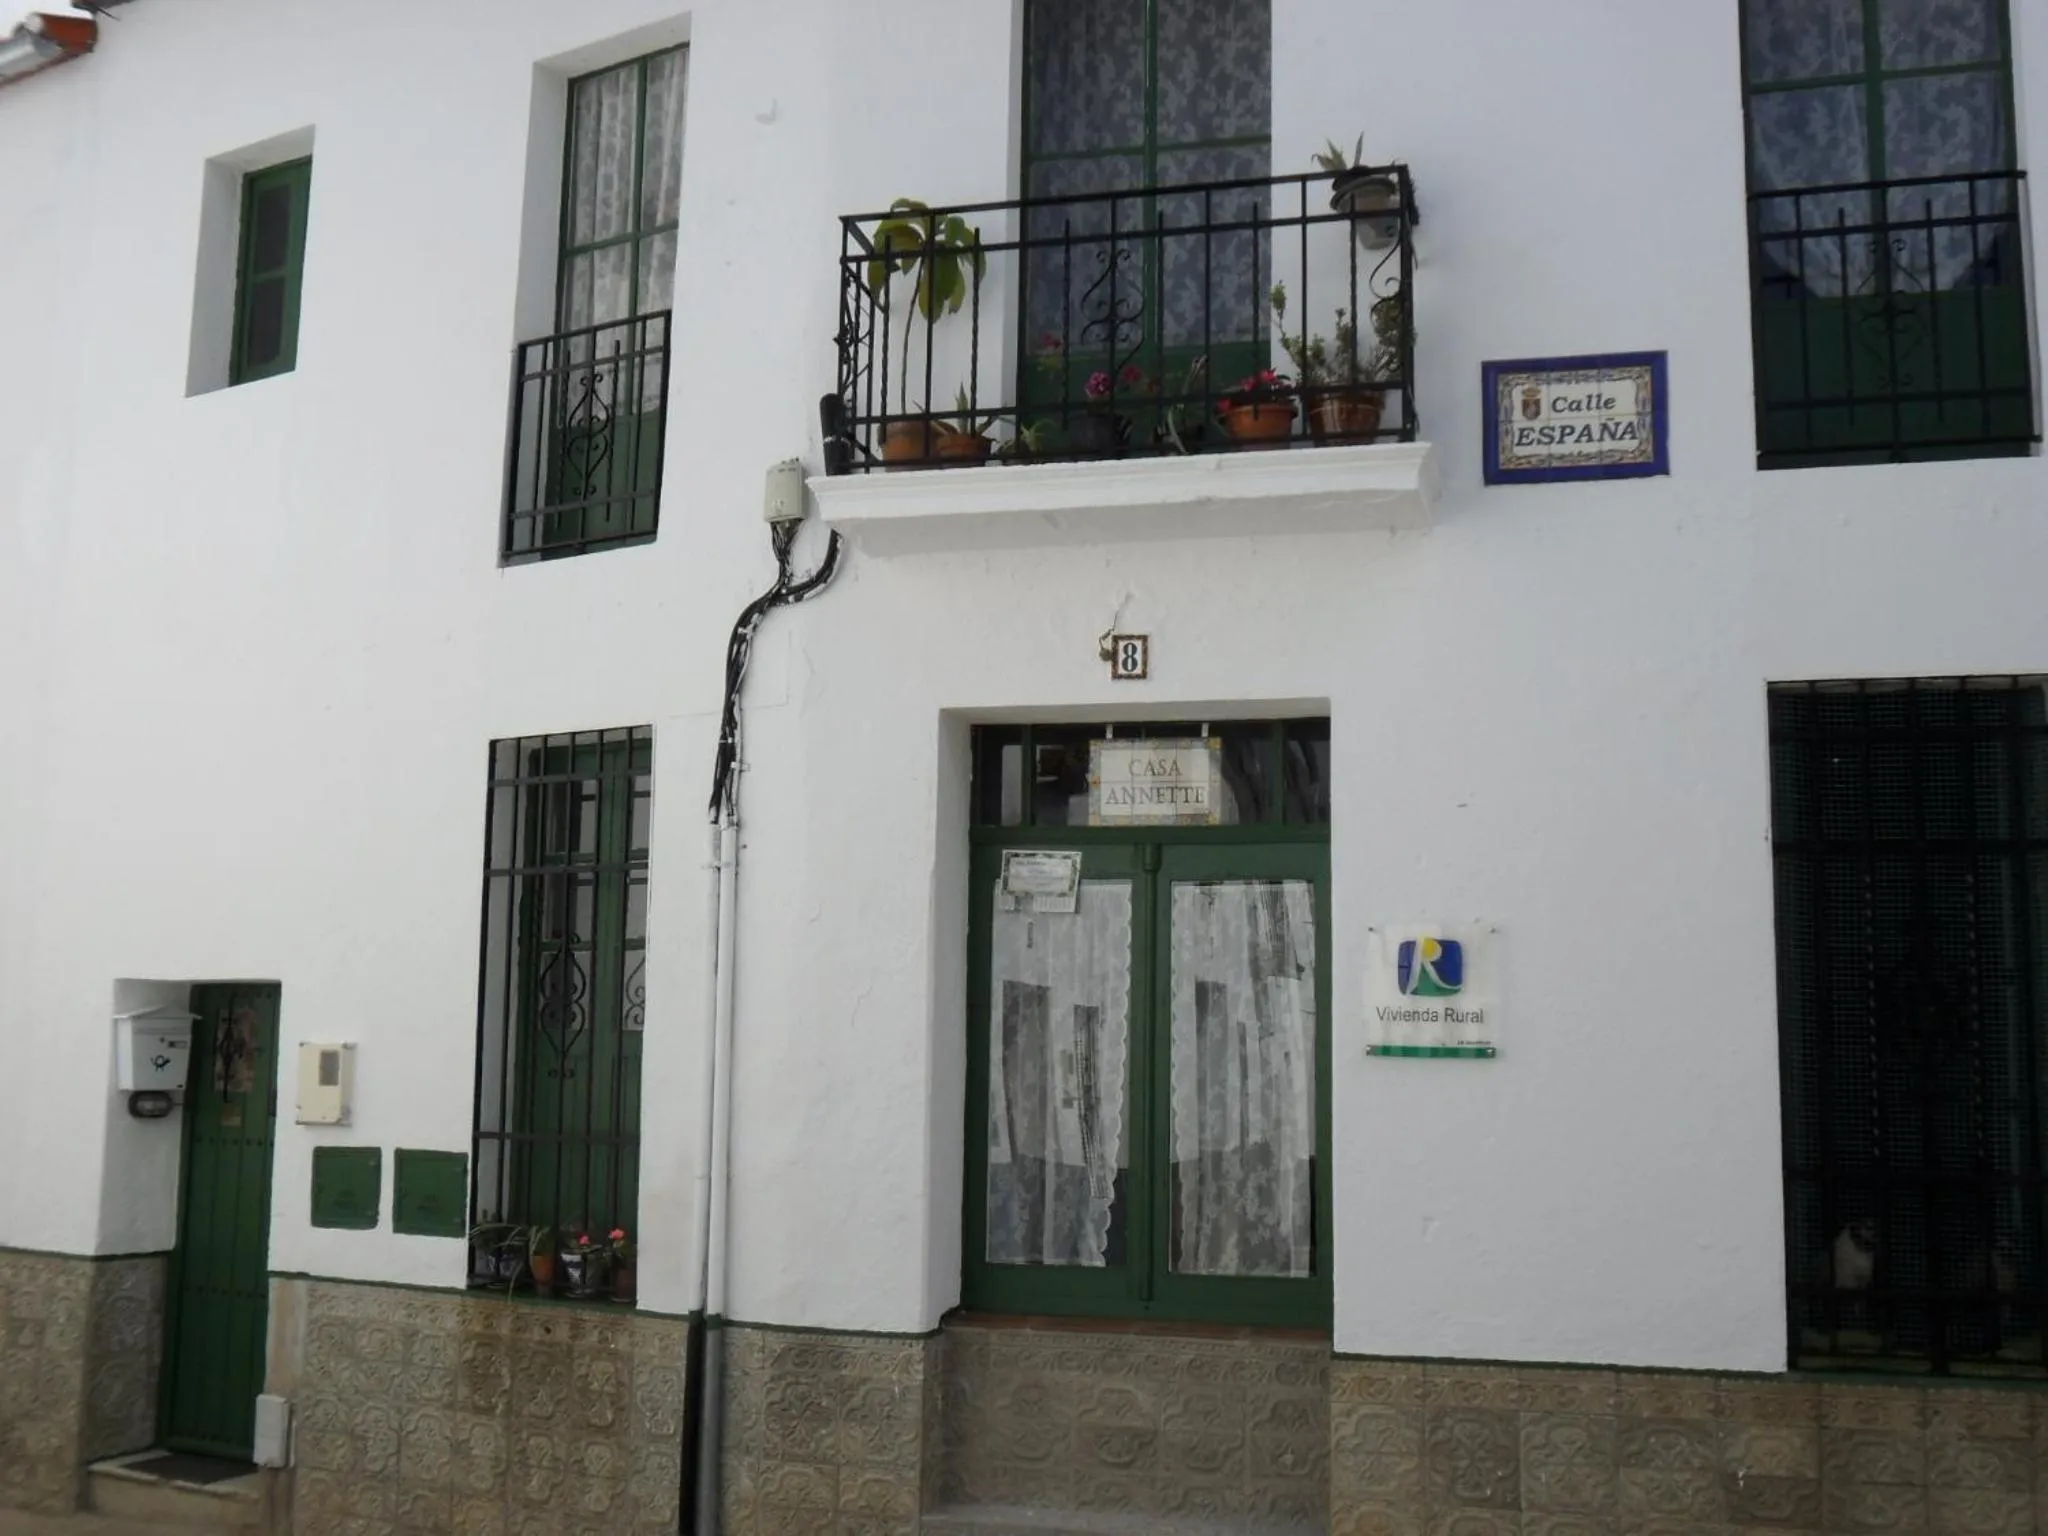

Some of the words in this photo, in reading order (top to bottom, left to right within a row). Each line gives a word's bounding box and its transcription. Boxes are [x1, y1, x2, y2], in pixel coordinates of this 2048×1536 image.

[1552, 394, 1616, 413] Calle
[1516, 417, 1638, 446] ESPAÑA
[1122, 642, 1138, 673] 8
[1128, 759, 1182, 776] CASA
[1105, 786, 1205, 804] ANNETTE
[1376, 1006, 1439, 1022] Vivienda
[1444, 1007, 1484, 1024] Rural
